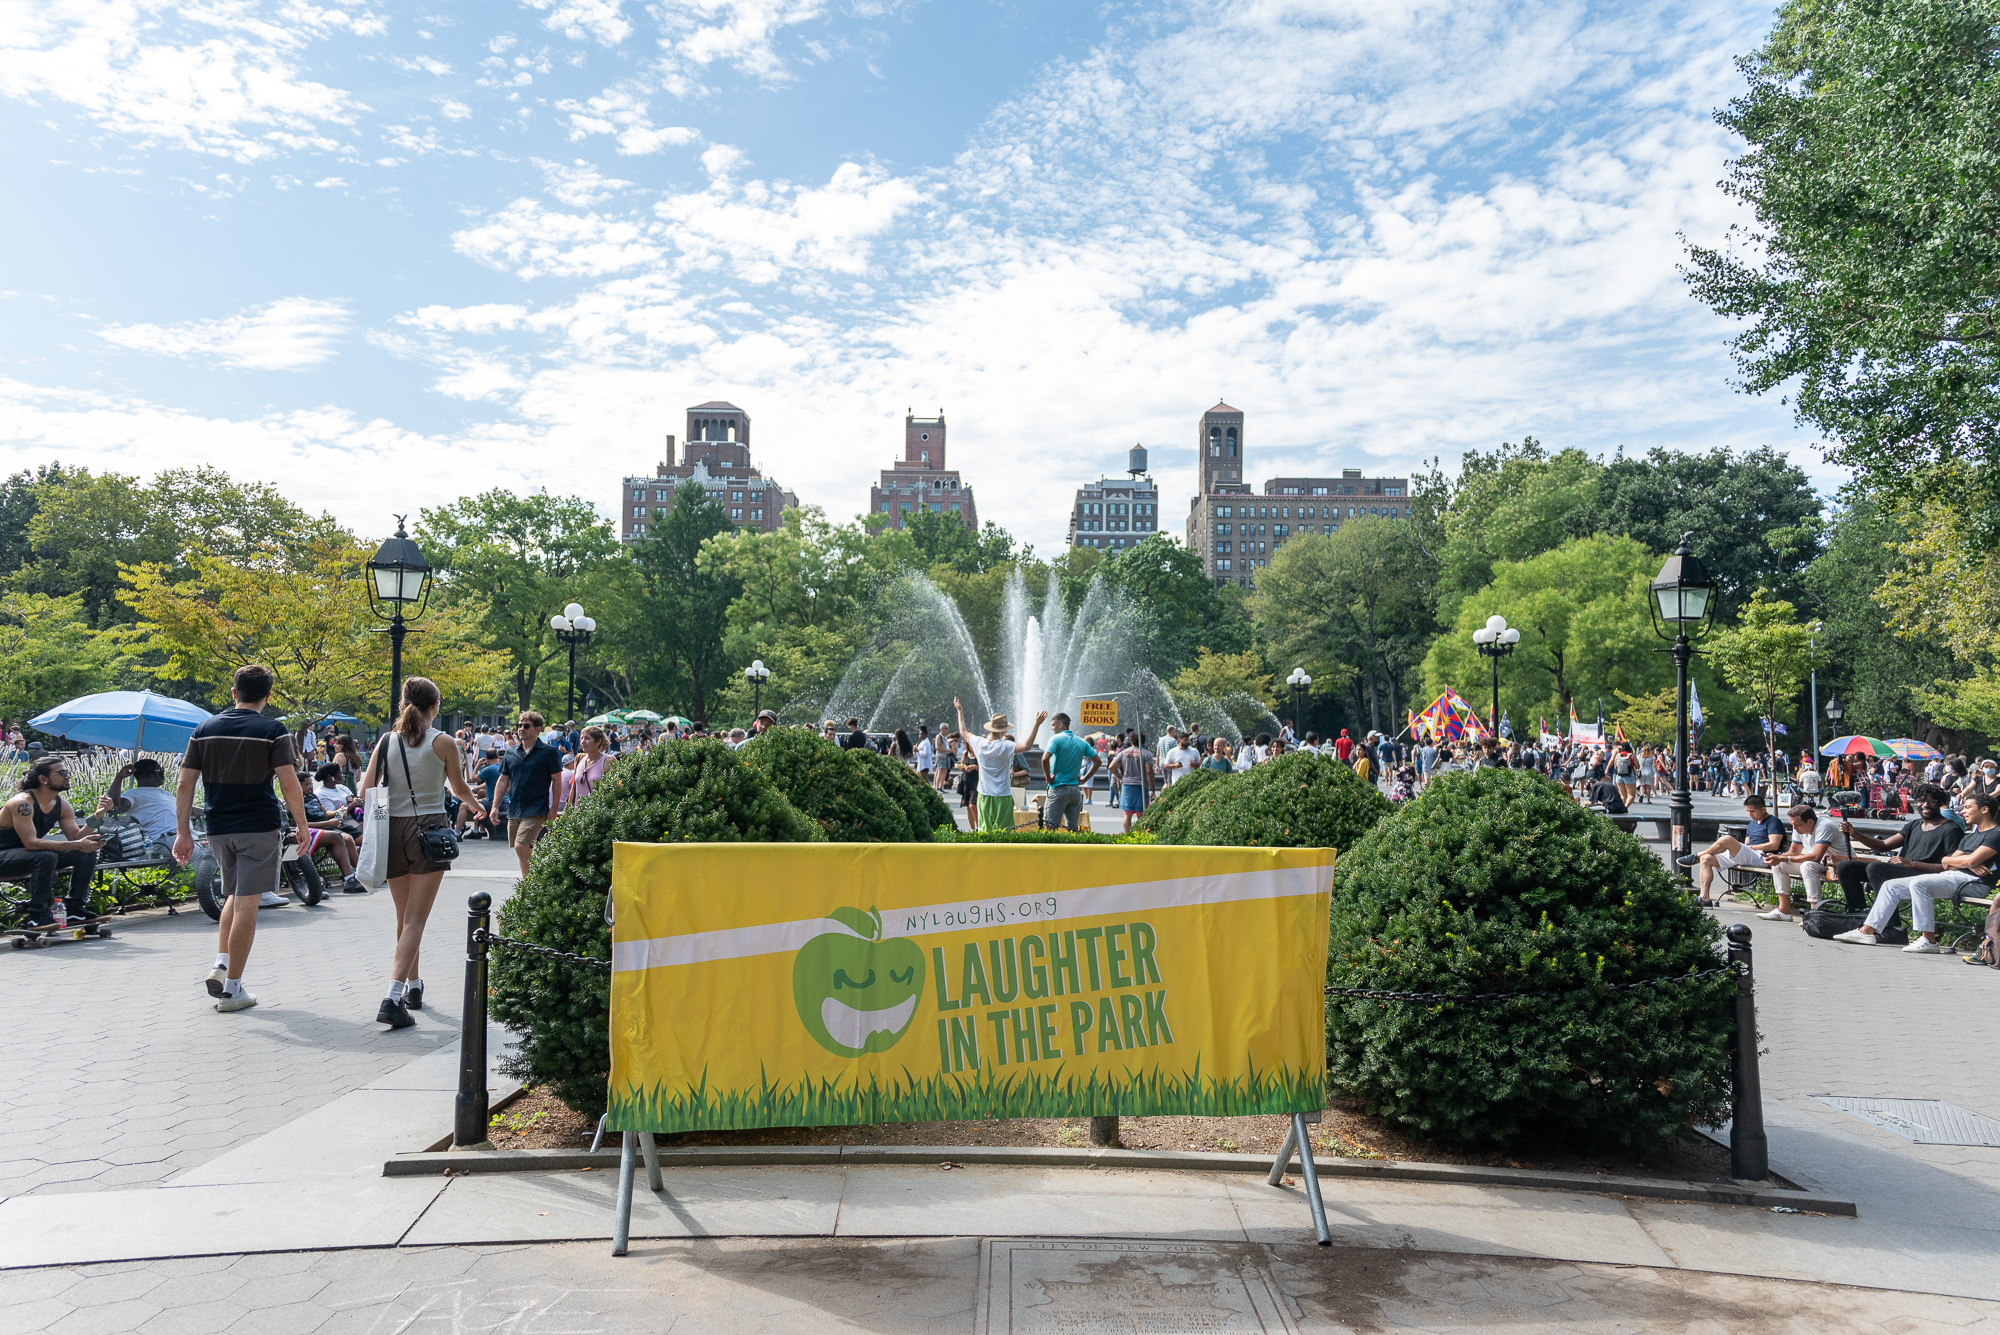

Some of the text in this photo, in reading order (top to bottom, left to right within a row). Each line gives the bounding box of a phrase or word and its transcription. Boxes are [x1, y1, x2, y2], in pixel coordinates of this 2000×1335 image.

[1083, 716, 1115, 724] BOOKS
[932, 922, 1163, 1012] LAUGHTER
[937, 989, 1175, 1074] IN THE PARK
[1104, 1293, 1154, 1301] PARK
